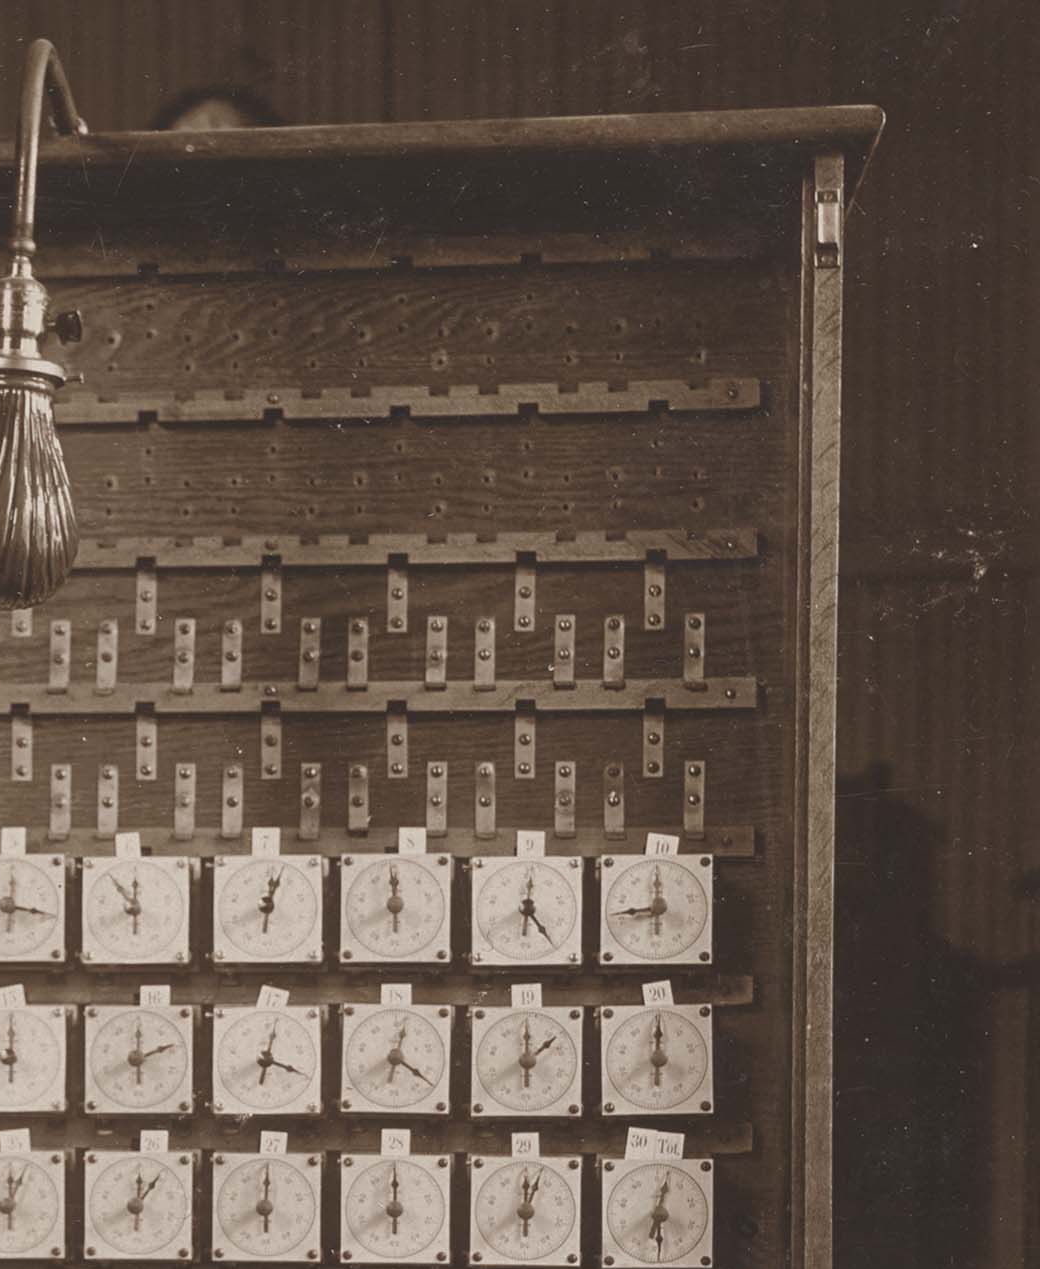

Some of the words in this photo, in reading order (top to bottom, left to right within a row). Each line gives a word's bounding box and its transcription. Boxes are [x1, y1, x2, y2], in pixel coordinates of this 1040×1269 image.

[406, 837, 415, 849] 8
[526, 838, 535, 850] 9
[655, 839, 671, 855] 10
[389, 988, 403, 1001] 18
[520, 990, 535, 1005] 19
[648, 985, 666, 1001] 20
[264, 1137, 280, 1152] 27
[387, 1135, 404, 1150] 28
[515, 1137, 532, 1153] 29
[630, 1133, 648, 1149] 30
